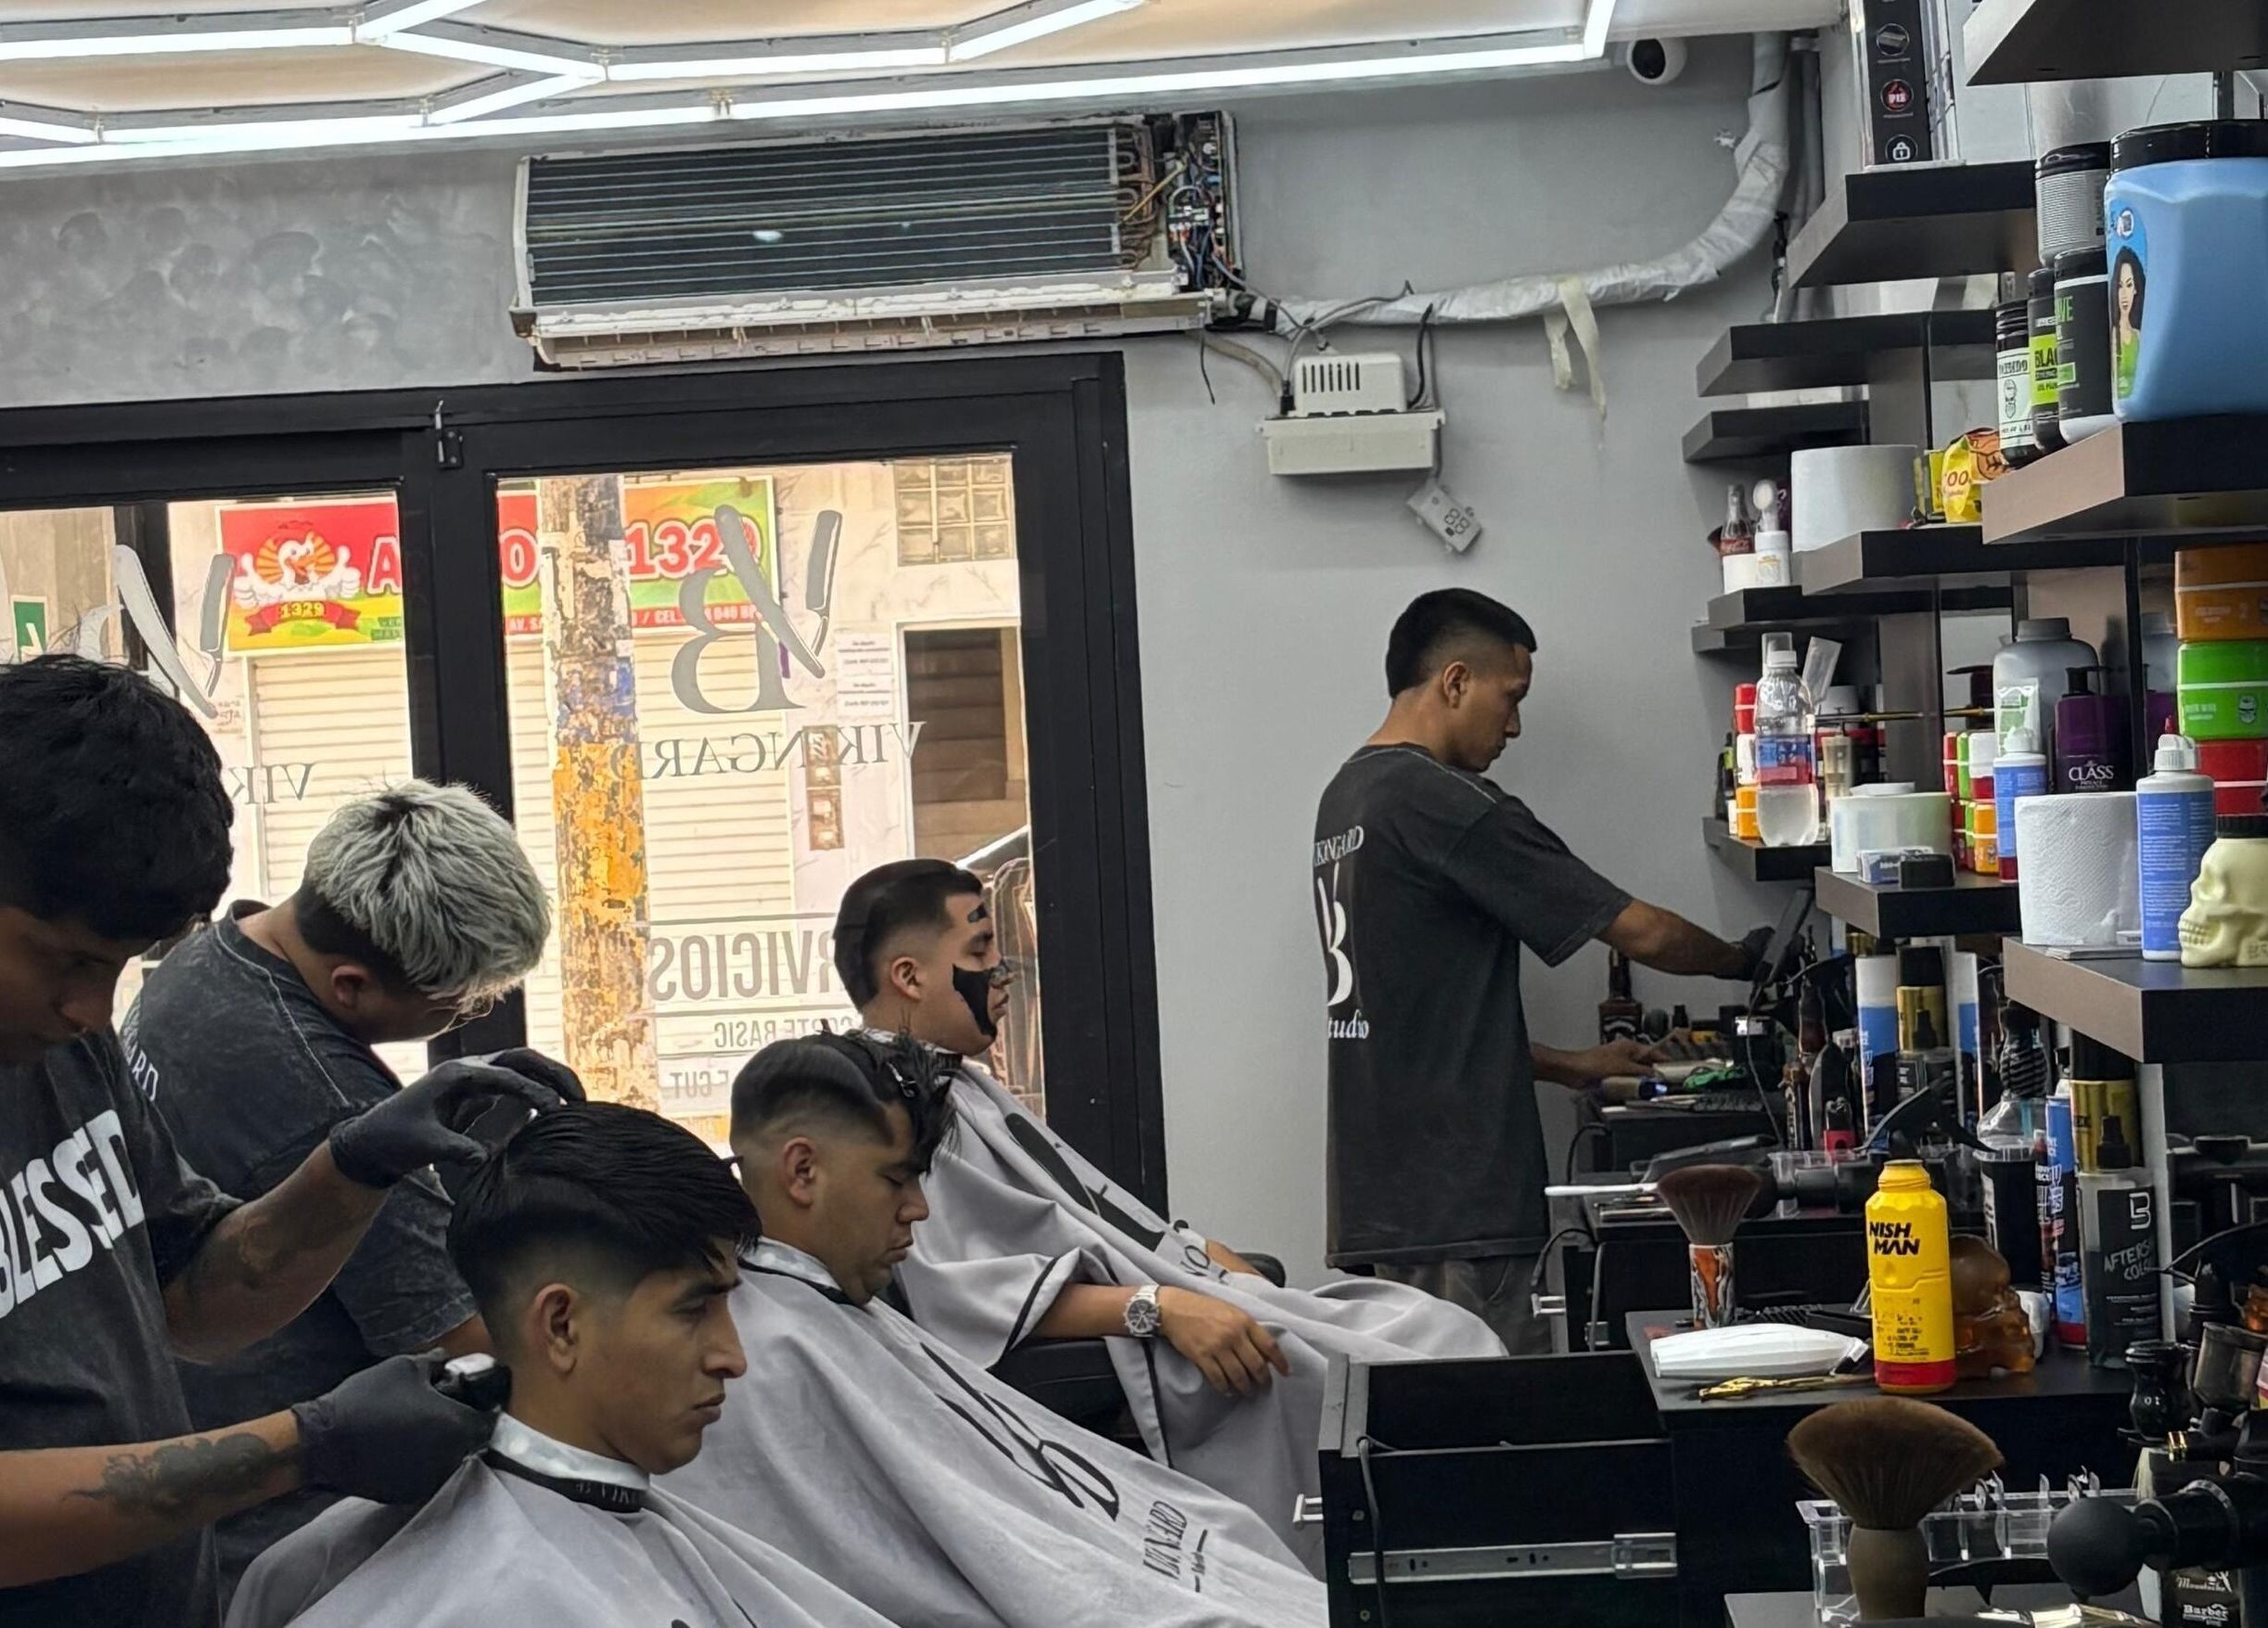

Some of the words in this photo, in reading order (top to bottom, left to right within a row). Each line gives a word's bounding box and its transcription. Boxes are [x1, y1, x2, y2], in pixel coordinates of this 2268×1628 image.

[280, 602, 325, 620] 1329
[2069, 765, 2114, 781] CLASS
[1869, 1222, 1912, 1238] NISH
[1874, 1238, 1921, 1255] MAN
